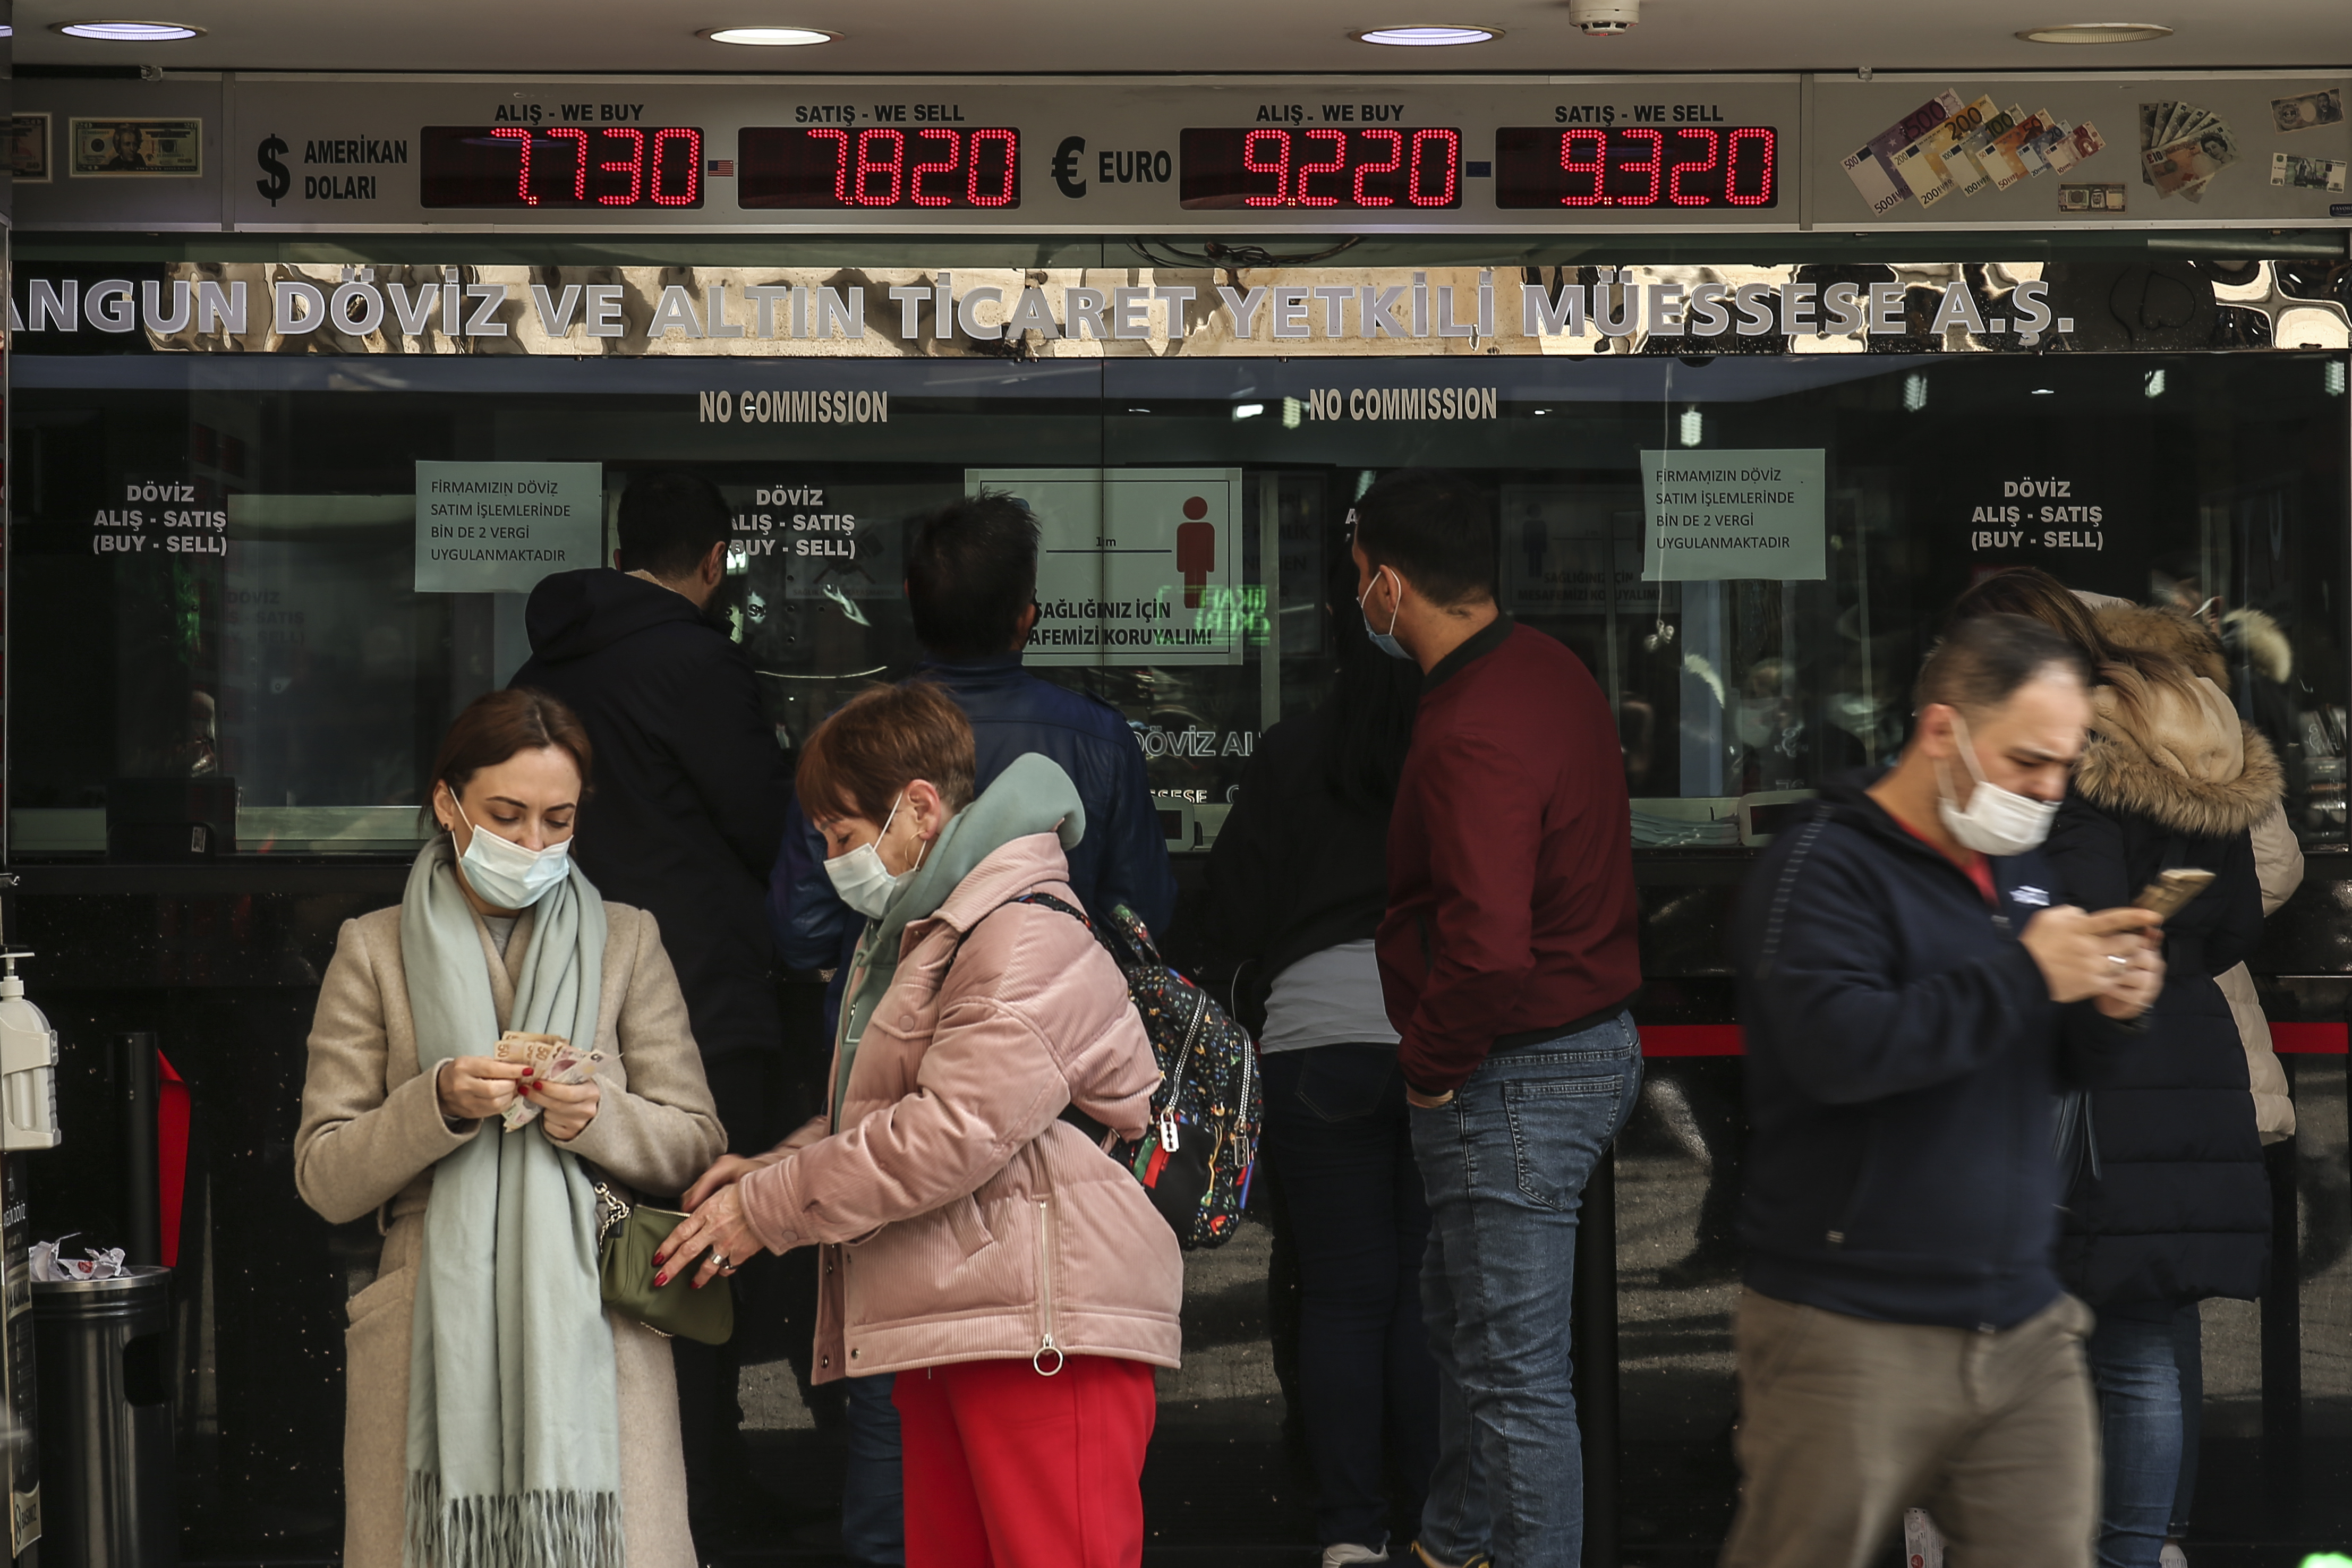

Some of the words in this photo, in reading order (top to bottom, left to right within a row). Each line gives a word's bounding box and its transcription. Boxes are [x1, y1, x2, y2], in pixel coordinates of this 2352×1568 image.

[495, 105, 539, 126] ALIŞ
[560, 105, 593, 122] WE
[600, 105, 644, 122] BUY
[795, 105, 856, 126] SATIŞ
[874, 105, 906, 122] WE
[914, 105, 964, 122] SELL
[1256, 105, 1303, 126] ALIŞ
[1323, 105, 1354, 122] WE
[1361, 105, 1404, 122] BUY
[1555, 105, 1615, 126] SATIŞ
[1634, 105, 1665, 122] WE
[1673, 105, 1723, 122] SELL
[1945, 106, 1983, 141] 200
[1985, 113, 2014, 138] 100
[304, 134, 407, 164] AMERİKAN
[1894, 152, 1909, 166] 200
[1942, 150, 1953, 161] 100
[2146, 150, 2163, 164] £10
[256, 133, 291, 207] $
[1051, 135, 1087, 199] €
[1098, 150, 1172, 184] EURO
[1844, 156, 1859, 170] 500
[305, 175, 376, 200] DOLARI
[275, 268, 507, 336] DÖVİZ
[531, 284, 624, 337] VE
[647, 285, 864, 338] ALTIN
[889, 272, 1197, 340] TİCARET
[1216, 271, 1494, 339] YETKİLİ
[1523, 270, 1906, 336] MÜESSESE
[1930, 280, 2074, 346] A.Ş.
[700, 390, 732, 423] NO
[740, 390, 888, 423] COMMISSION
[1309, 388, 1342, 421] NO
[1350, 387, 1497, 421] COMMISSION
[1656, 468, 1737, 482] FİRMAMIZIN
[1741, 467, 1781, 482] DÖVİZ
[127, 481, 194, 502] DÖVİZ
[431, 479, 513, 495] FİRMAMIZIN
[517, 479, 558, 495] DÖVİZ
[756, 485, 823, 506] DÖVİZ
[2004, 477, 2070, 498] DÖVİZ
[1656, 492, 1697, 505] SATIM
[1701, 490, 1794, 507] İŞLEMLERİNDE
[94, 510, 143, 531] ALIŞ
[164, 510, 227, 532] SATIŞ
[431, 504, 473, 516] SATIM
[476, 502, 570, 519] İŞLEMLERİNDE
[1656, 513, 1678, 526] BİN
[1682, 514, 1700, 526] DE
[1703, 514, 1711, 526] 2
[1715, 512, 1754, 526] VERGİ
[1972, 506, 2019, 526] ALIŞ
[2041, 506, 2102, 526] SATIŞ
[431, 525, 454, 539] BİN
[457, 526, 475, 539] DE
[479, 526, 487, 539] 2
[489, 525, 530, 539] VERGİ
[793, 514, 855, 535] SATIŞ
[93, 535, 146, 555] (BUY
[166, 536, 227, 556] SELL)
[731, 540, 776, 556] BUY
[796, 540, 856, 559] SELL)
[1656, 536, 1790, 550] UYGULANMAKTADIR
[1971, 532, 2023, 550] (BUY
[2044, 532, 2103, 550] SELL)
[431, 549, 566, 562] UYGULANMAKTADIR
[1136, 598, 1171, 624] İÇİN
[1104, 629, 1212, 645] KORUYALIM!
